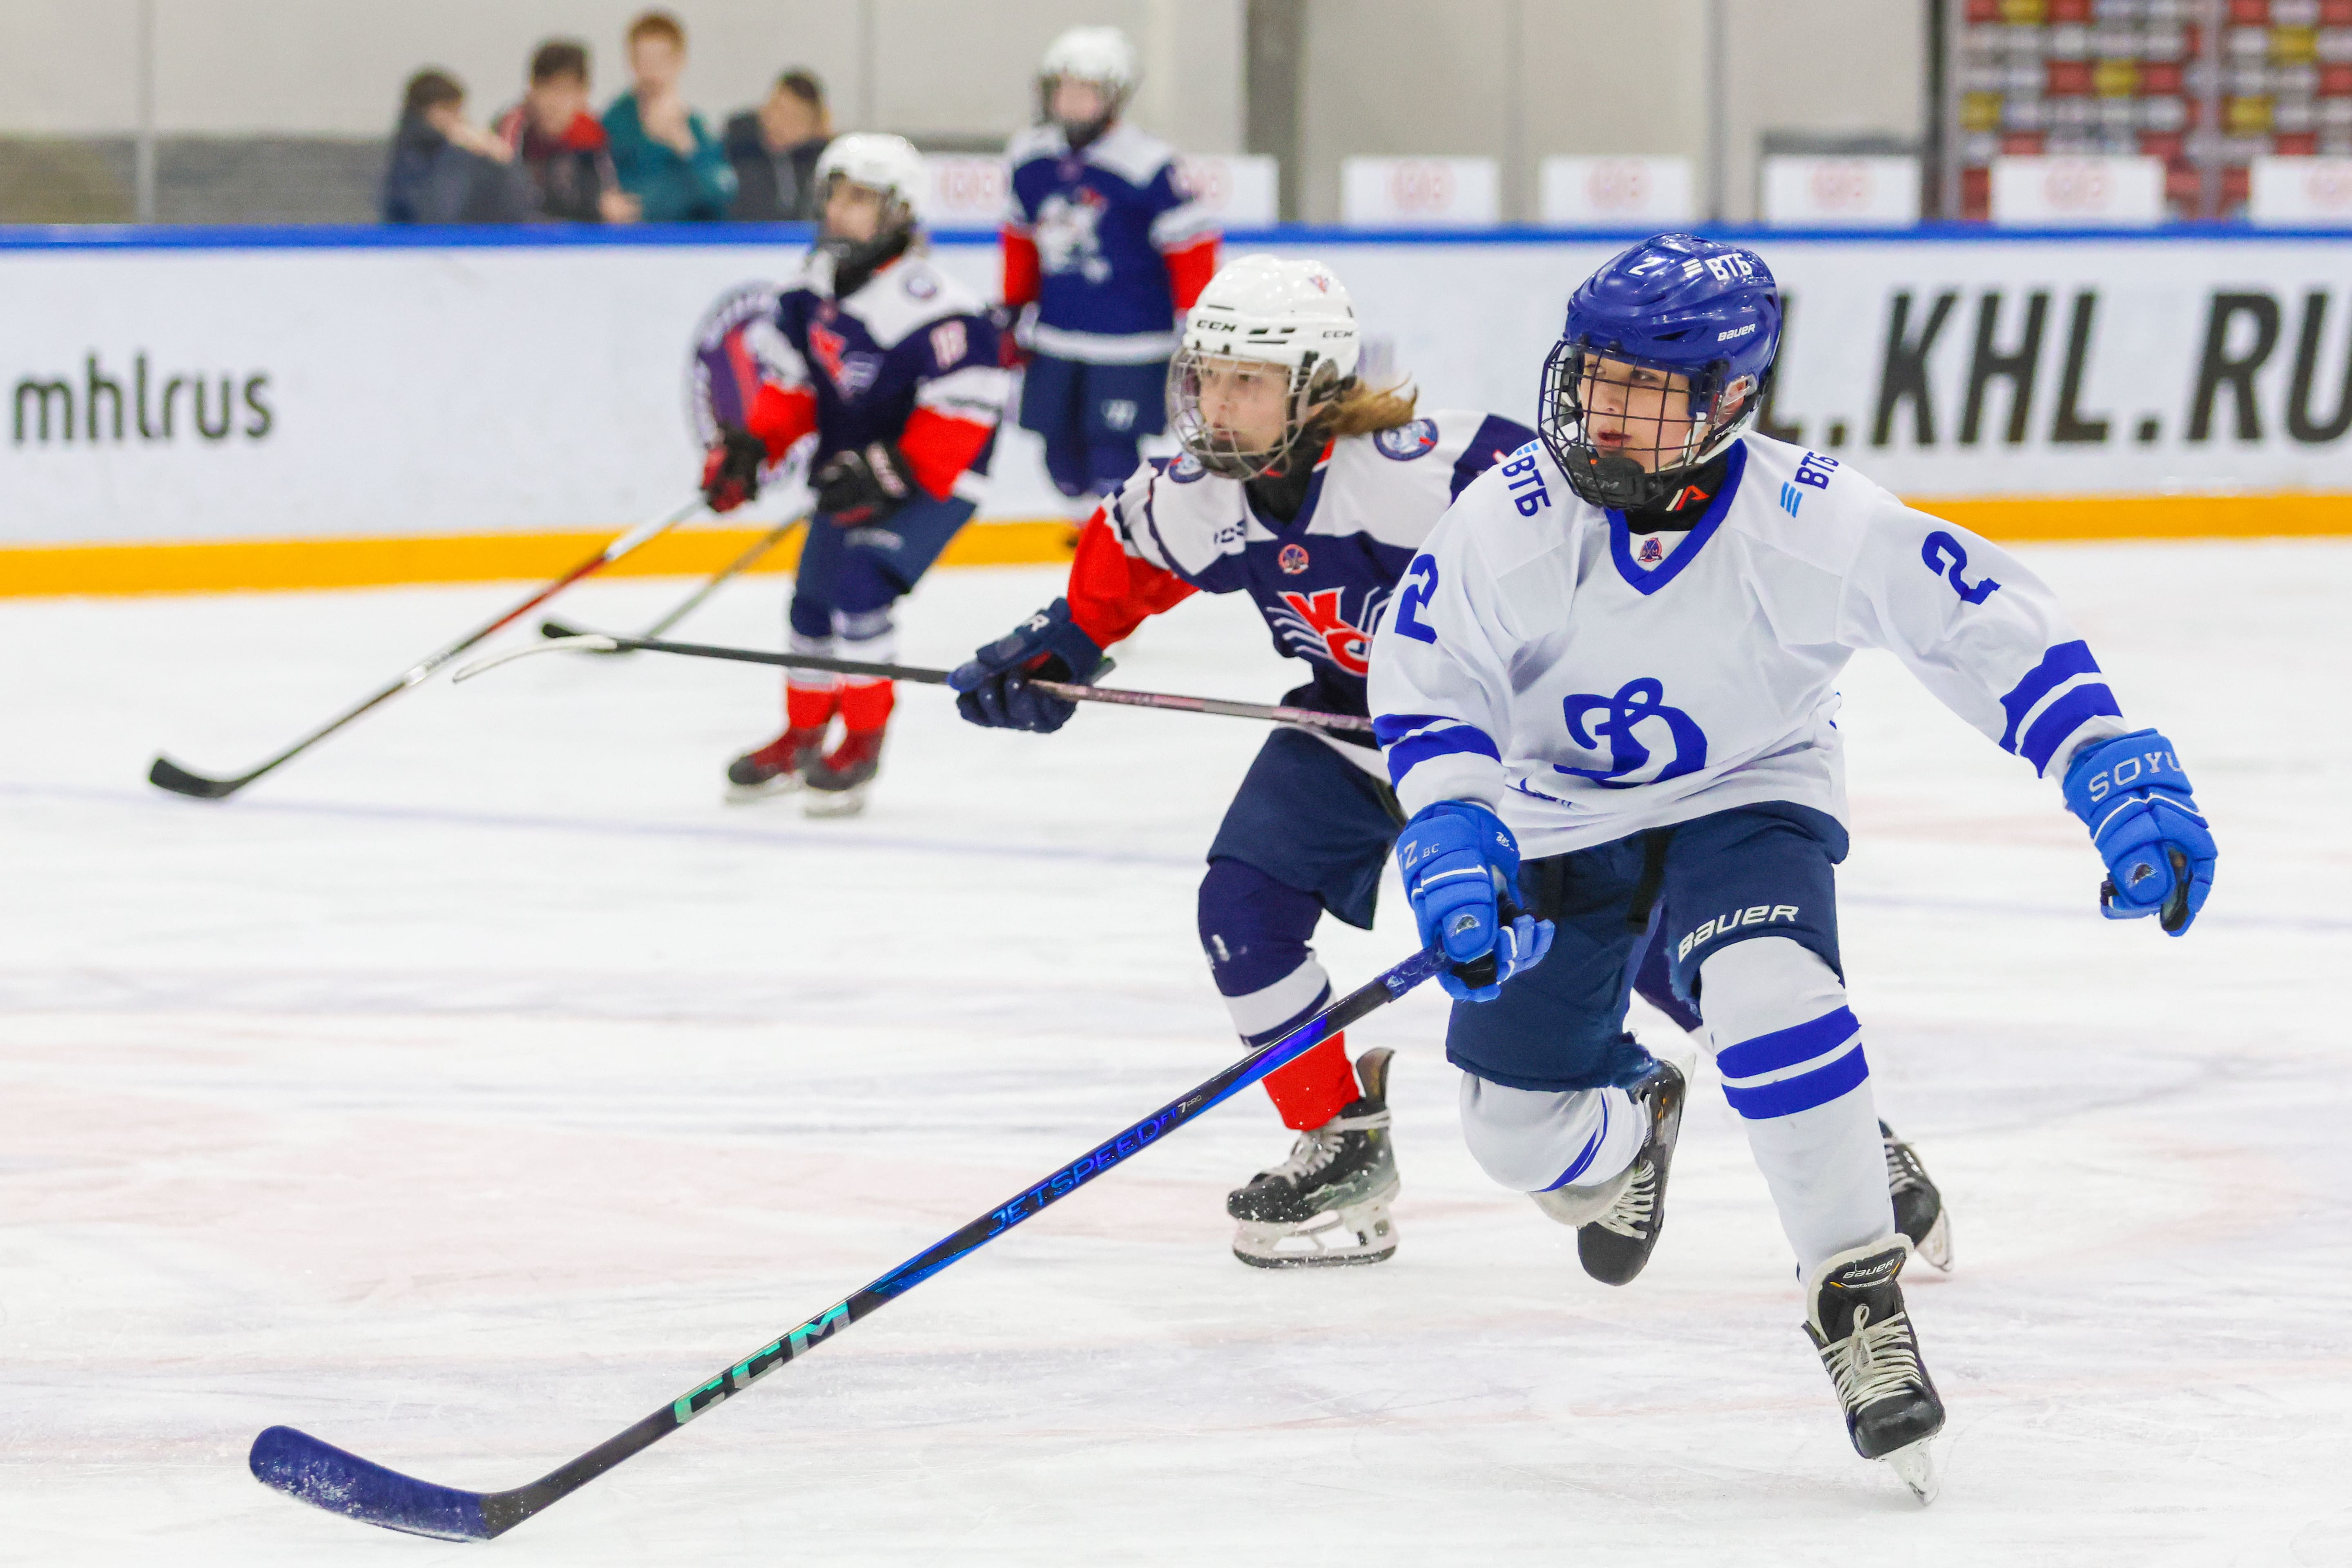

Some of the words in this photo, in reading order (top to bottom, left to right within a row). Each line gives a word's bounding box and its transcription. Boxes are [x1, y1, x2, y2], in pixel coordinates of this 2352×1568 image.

[1628, 257, 1667, 276] 2
[1705, 253, 1752, 281] ВТБ
[1197, 320, 1236, 332] CCM
[1323, 330, 1353, 339] CCM
[1717, 323, 1756, 341] BAUER
[15, 354, 272, 441] mhlrus
[1502, 455, 1551, 517] ВТБ
[1794, 451, 1839, 489] ВТБ
[1921, 531, 2001, 605] 2
[1395, 554, 1438, 645] 2
[1422, 843, 1439, 858] BC
[1678, 905, 1799, 963] BAUER
[988, 1120, 1160, 1236] JETSPEED
[1843, 1258, 1886, 1279] BAUER
[674, 1301, 851, 1424] CCM
